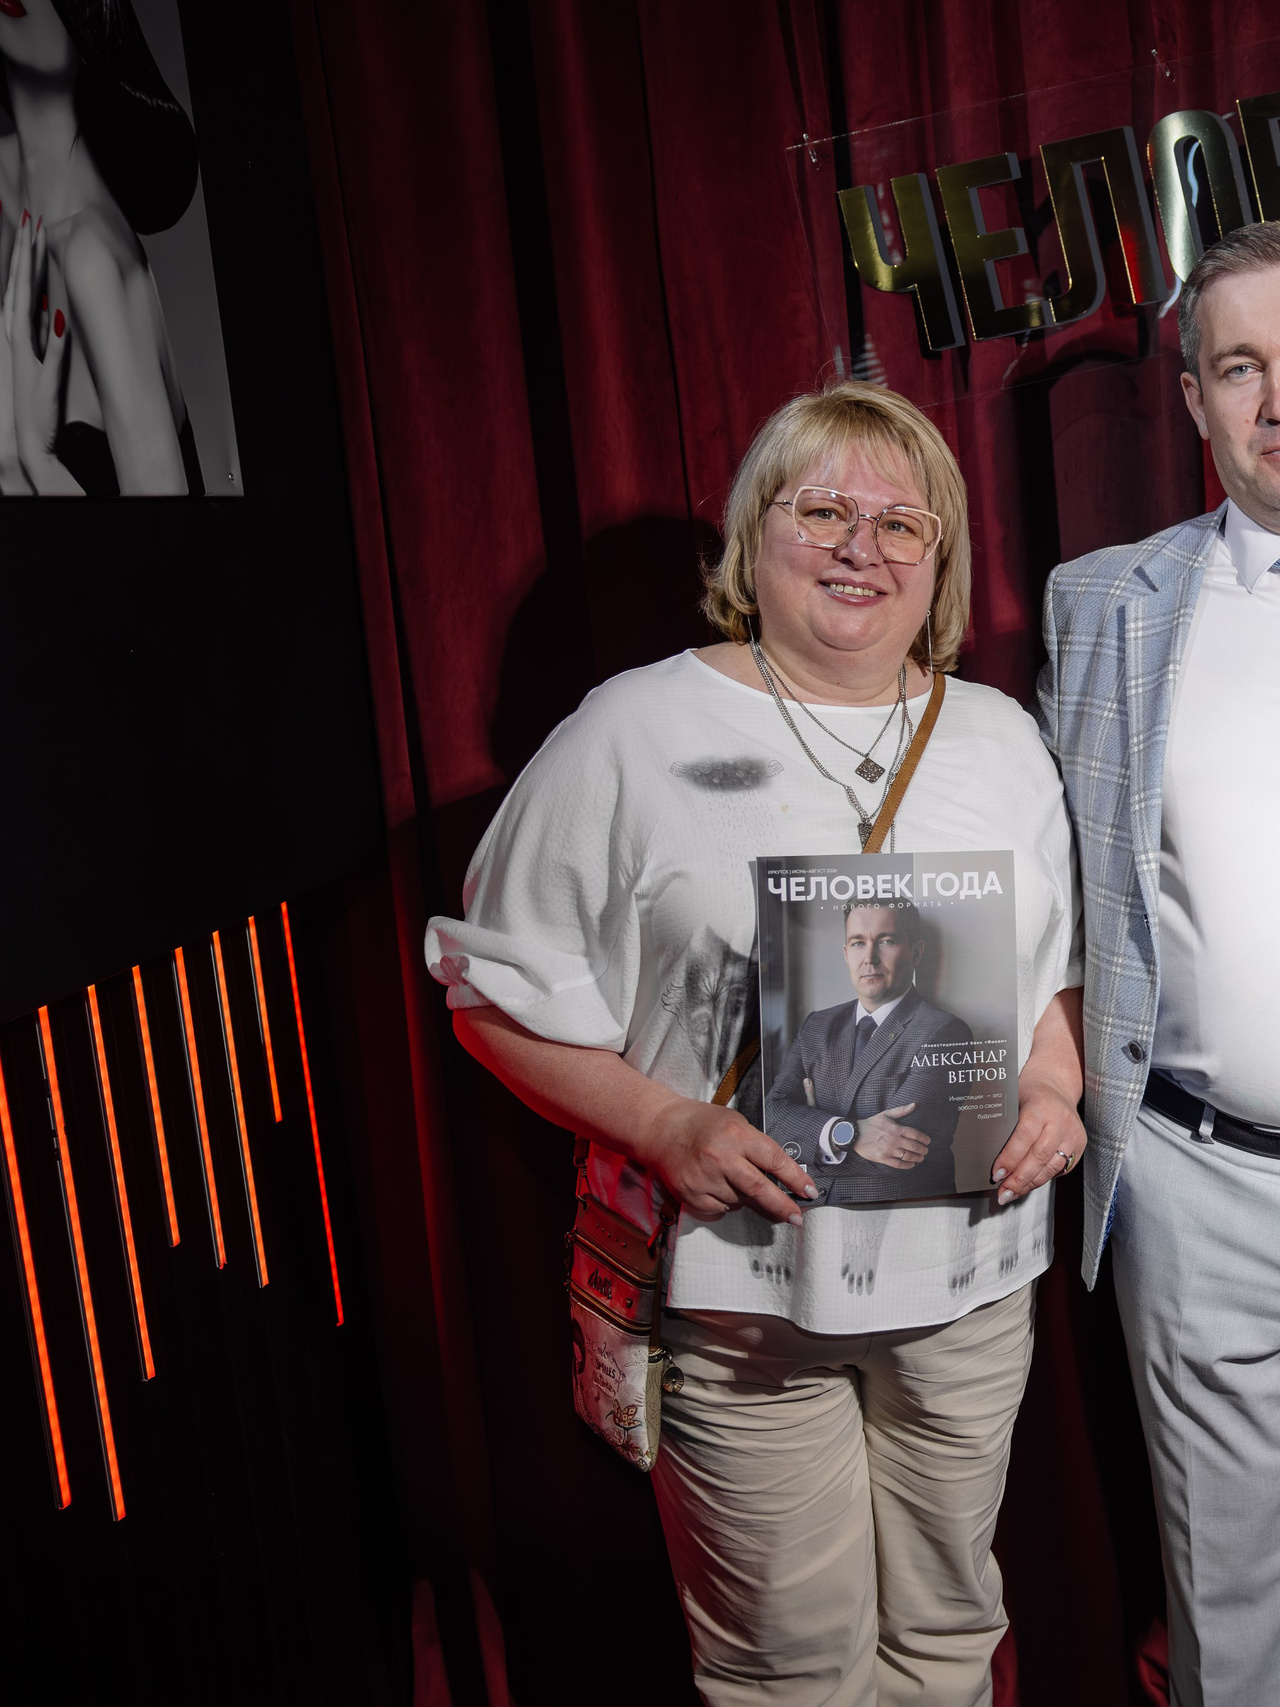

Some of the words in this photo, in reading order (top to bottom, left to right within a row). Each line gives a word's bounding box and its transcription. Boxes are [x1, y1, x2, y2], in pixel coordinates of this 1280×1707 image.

[767, 874, 913, 902] ЧЕЛОВЕК
[922, 871, 1004, 900] ГОДА
[833, 903, 880, 911] НОВОГО
[888, 901, 943, 909] ФОРМАТА
[910, 1049, 1007, 1068] АЛЕКСАНДР
[948, 1067, 1007, 1084] ВЕТРОВ
[949, 1094, 984, 1102] Инвестиции
[977, 1112, 1003, 1120] будущем
